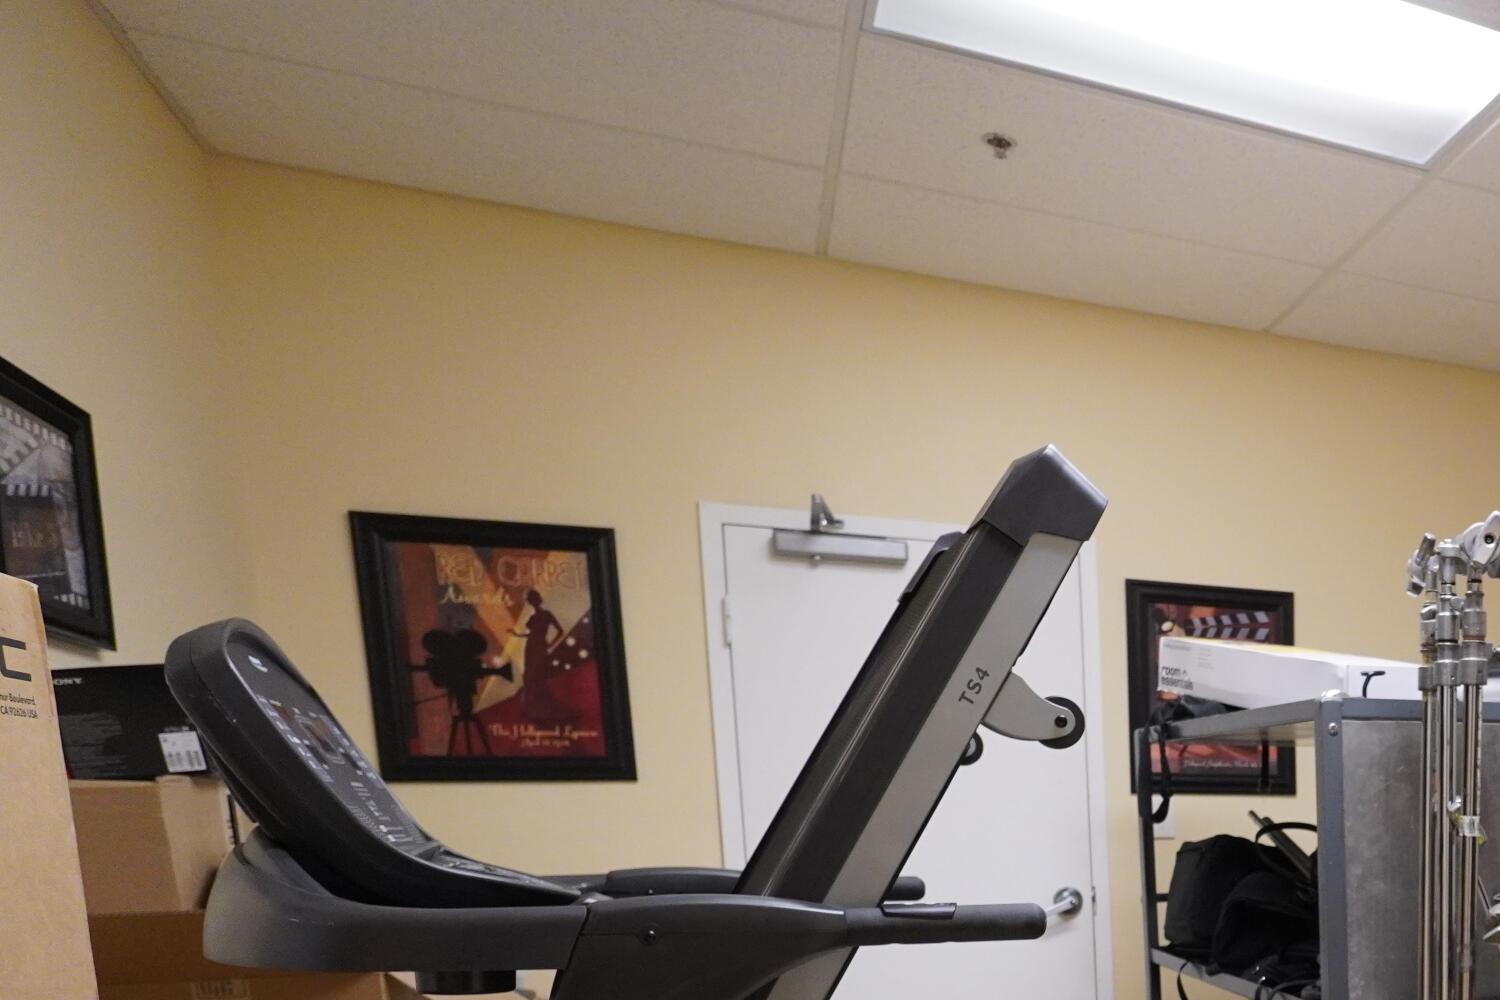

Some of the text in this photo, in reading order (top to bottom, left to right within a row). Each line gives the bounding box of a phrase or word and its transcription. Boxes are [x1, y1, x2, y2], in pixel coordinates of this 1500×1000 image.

[497, 556, 585, 591] CARPET
[53, 677, 82, 686] ONY
[958, 666, 990, 704] TS4
